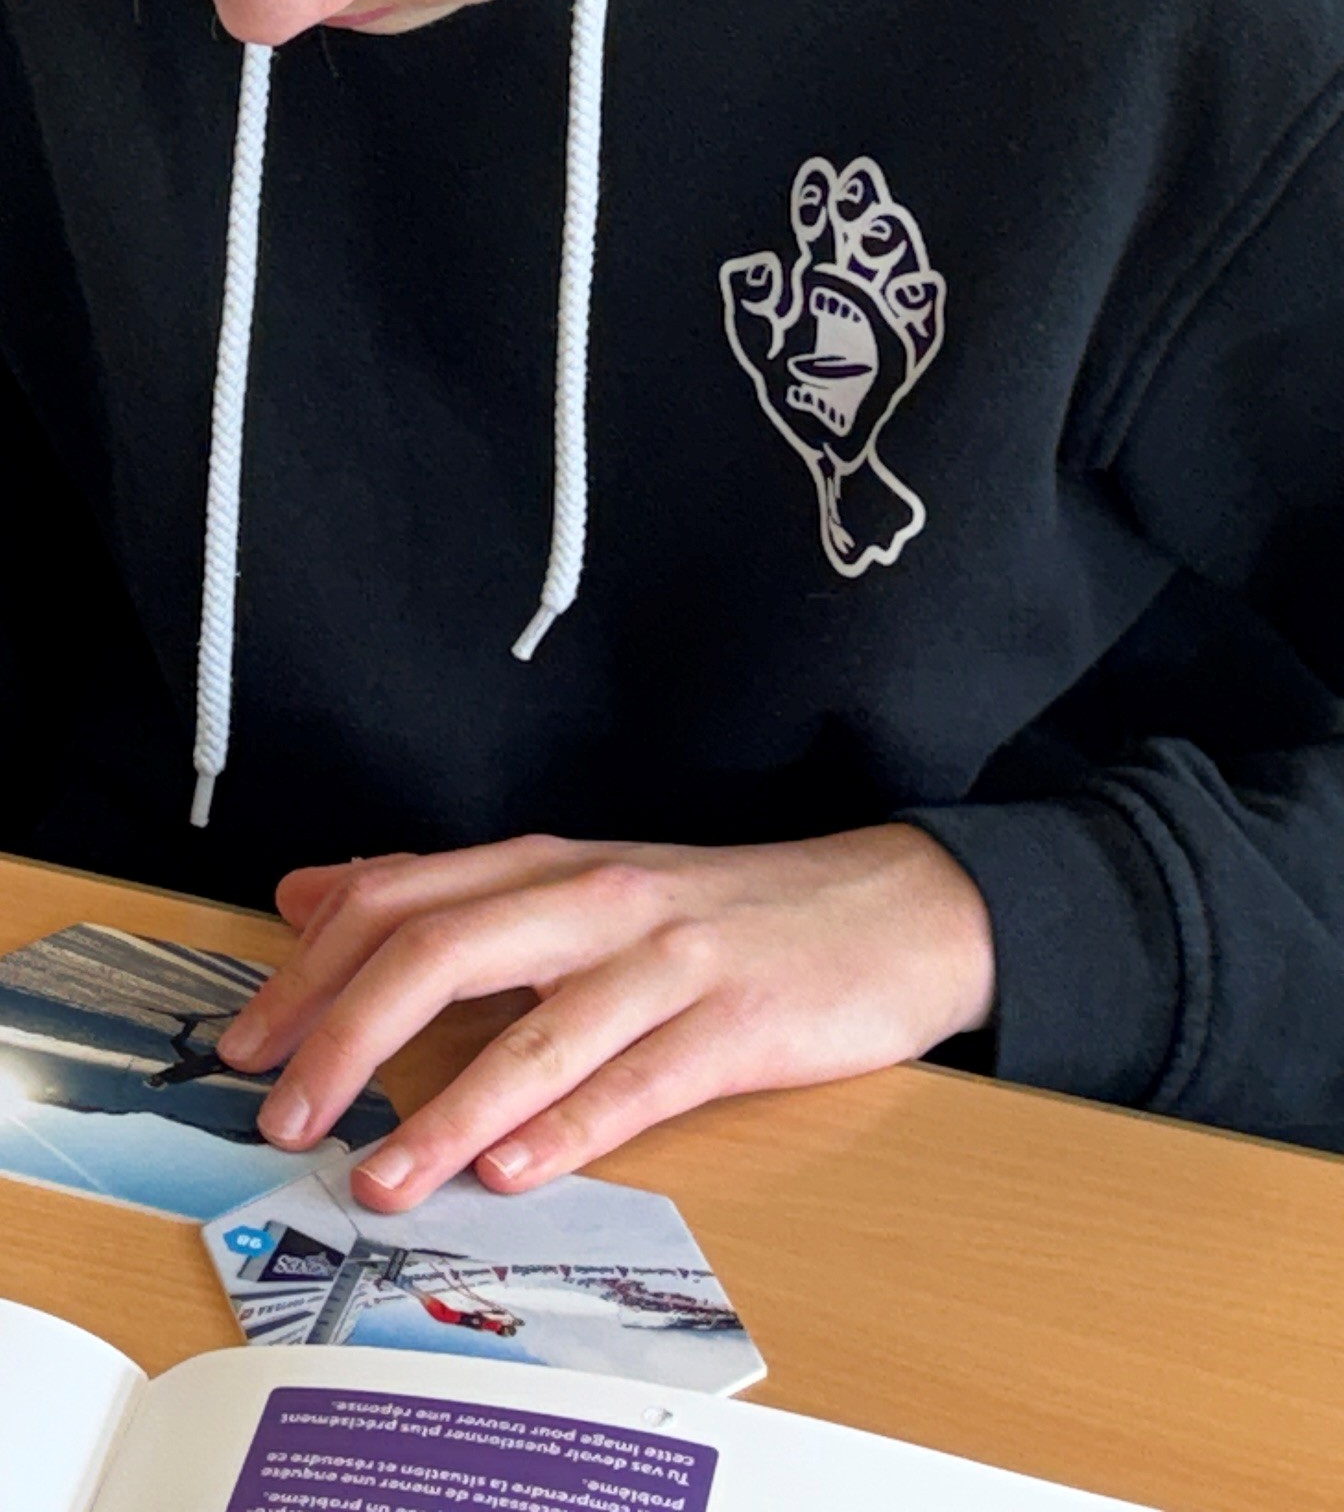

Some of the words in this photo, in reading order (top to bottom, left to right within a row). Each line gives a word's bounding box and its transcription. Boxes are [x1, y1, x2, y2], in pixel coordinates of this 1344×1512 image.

[332, 1401, 411, 1417] réponse.
[415, 1409, 451, 1422] une
[280, 1413, 398, 1430] précisément
[399, 1422, 442, 1437] plus
[455, 1415, 526, 1433] trouver
[443, 1429, 561, 1455] questionner
[529, 1426, 577, 1441] pour
[579, 1433, 639, 1456] image
[266, 1451, 288, 1462] ce
[290, 1453, 374, 1470] résoudre
[563, 1448, 627, 1470] devoir
[643, 1446, 695, 1466] cette
[260, 1466, 337, 1481] enquête
[376, 1461, 397, 1472] et
[630, 1460, 664, 1477] vas
[340, 1472, 376, 1486] une
[400, 1465, 485, 1487] situation
[666, 1468, 689, 1486] Tu
[378, 1478, 442, 1495] mener
[489, 1478, 508, 1492] la
[444, 1487, 469, 1502] de
[582, 1479, 685, 1510] problème.
